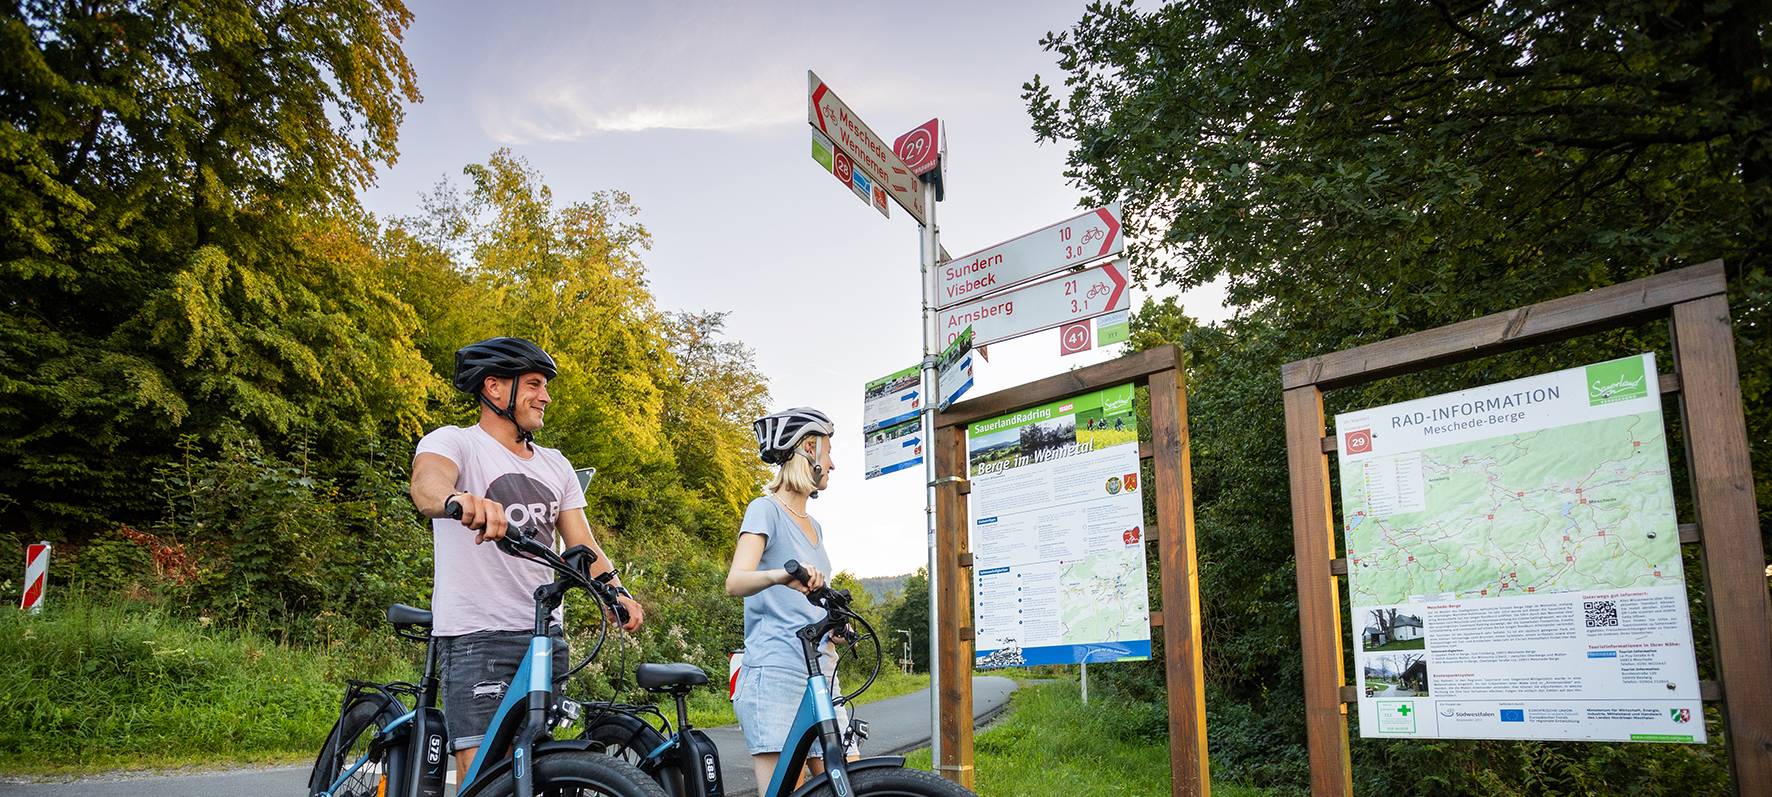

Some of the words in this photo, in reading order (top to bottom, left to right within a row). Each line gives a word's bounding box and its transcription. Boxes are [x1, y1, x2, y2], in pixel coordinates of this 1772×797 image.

[840, 108, 887, 162] Meschede
[839, 128, 890, 183] Wennemen
[906, 138, 924, 160] 29
[946, 254, 1003, 281] Sundern
[1059, 227, 1072, 242] 10
[946, 272, 996, 298] Visbeck
[948, 300, 1014, 328] Arnsberg
[1064, 280, 1077, 295] 21
[1068, 331, 1084, 344] 41
[1391, 386, 1560, 429] RAD-INFORMATION
[975, 408, 1051, 434] SauerlandRadring
[1423, 410, 1526, 436] Meschede-Berge
[1352, 438, 1365, 447] 29
[978, 458, 1010, 476] Berge
[1014, 454, 1029, 467] im
[1034, 438, 1095, 463] Wennetal
[429, 738, 440, 762] 572
